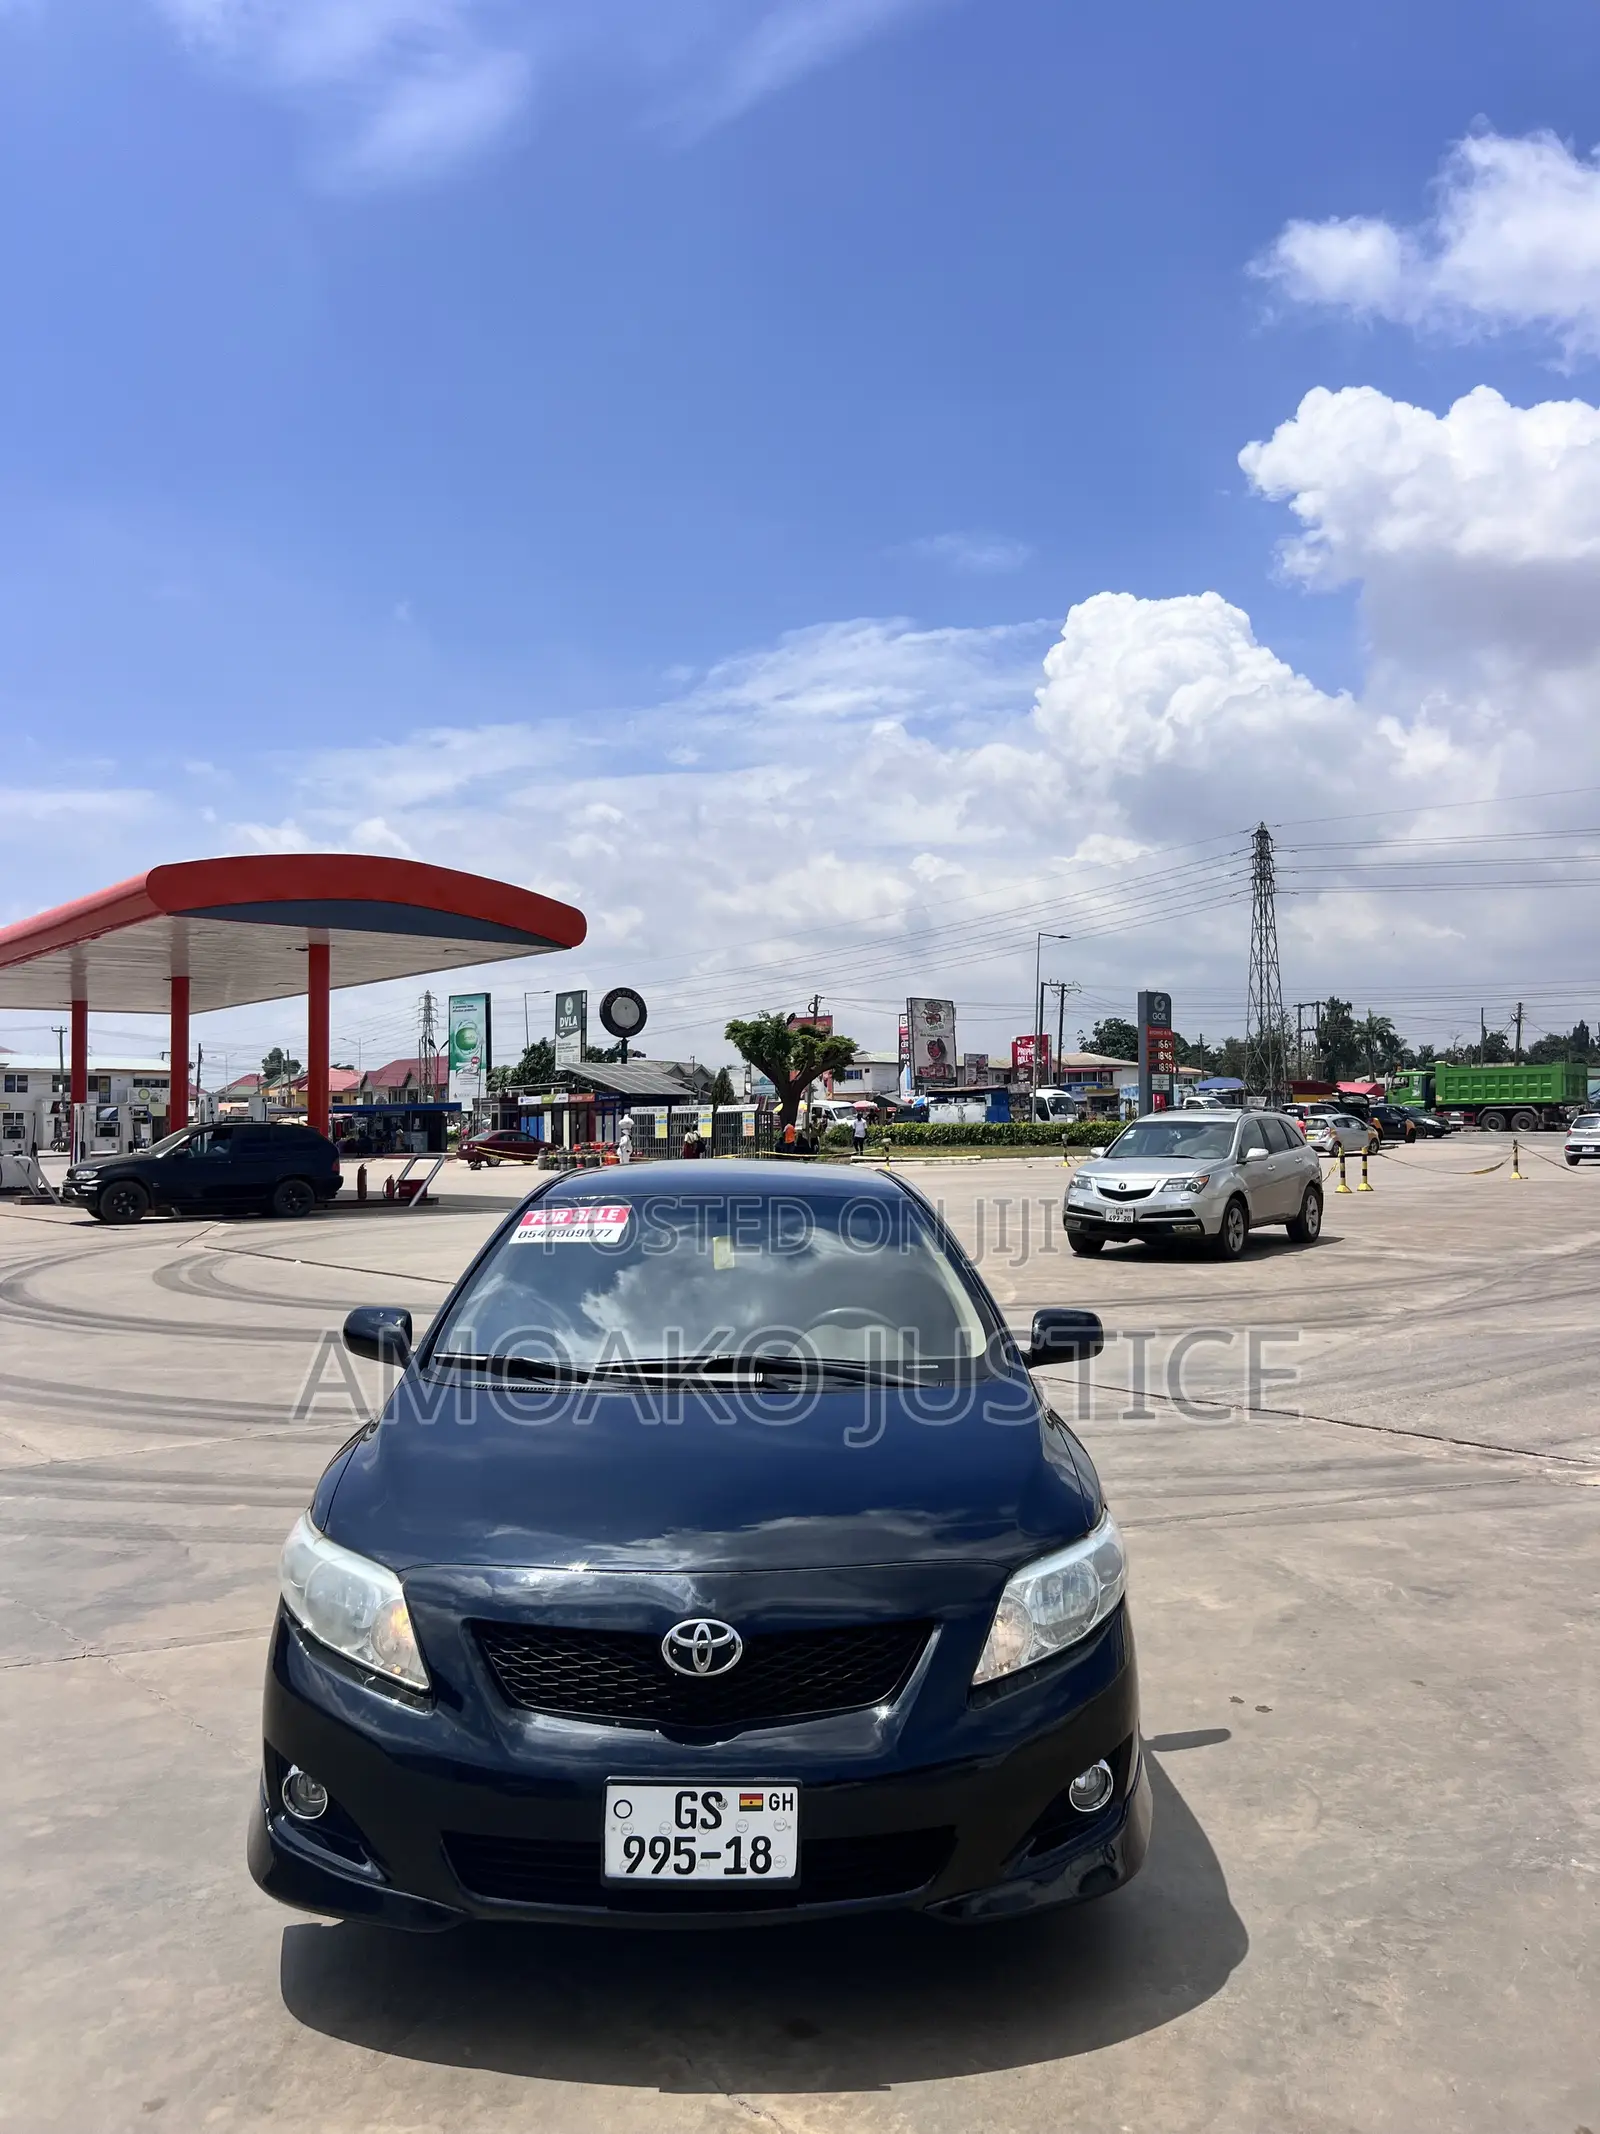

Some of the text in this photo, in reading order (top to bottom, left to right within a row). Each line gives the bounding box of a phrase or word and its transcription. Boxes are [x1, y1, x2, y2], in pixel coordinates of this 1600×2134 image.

[559, 1015, 578, 1028] DVLA
[1152, 1012, 1167, 1021] GOIL
[529, 1209, 621, 1224] FOR SALE
[675, 1791, 794, 1830] GS GH
[623, 1836, 772, 1875] 995-18
